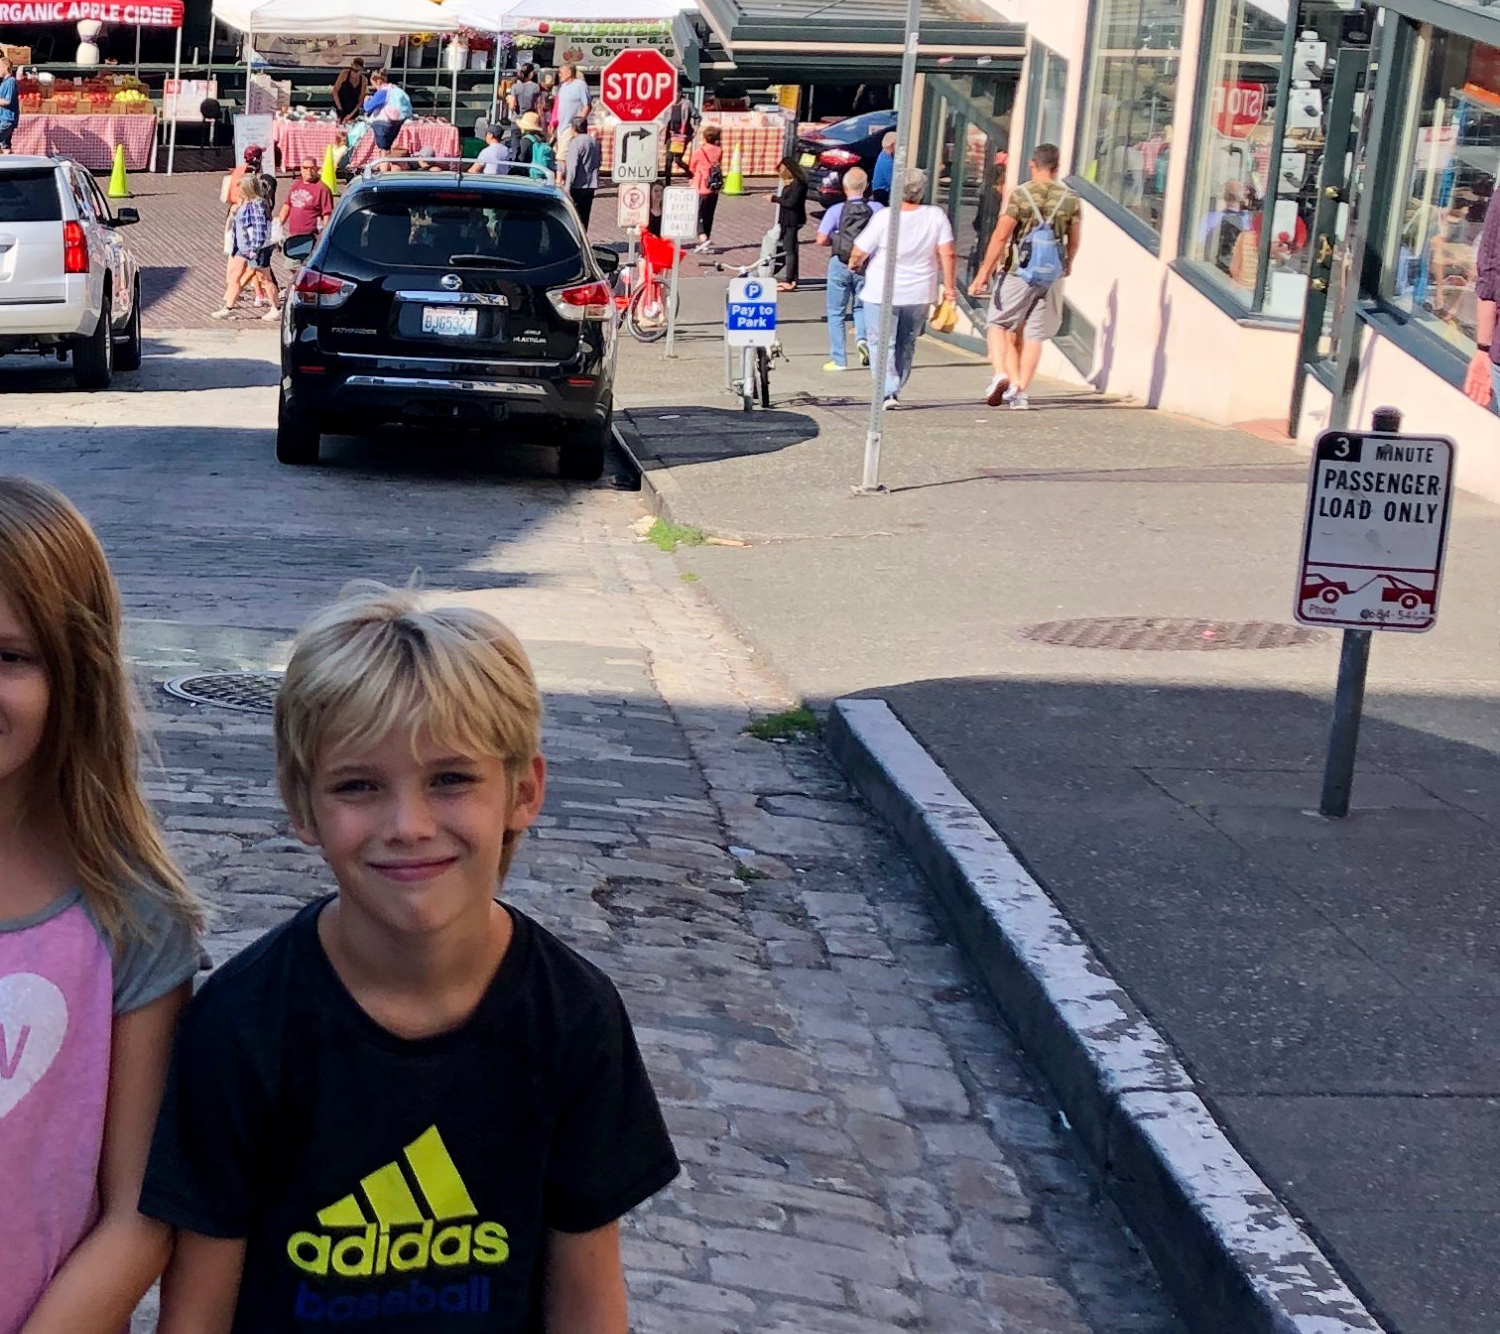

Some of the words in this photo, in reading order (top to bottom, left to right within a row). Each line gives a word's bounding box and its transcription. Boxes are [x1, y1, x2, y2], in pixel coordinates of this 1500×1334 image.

[67, 2, 121, 22] APPLE
[123, 5, 174, 25] CIDER
[605, 71, 672, 101] STOP
[617, 165, 653, 179] ONLY
[748, 284, 759, 297] P
[731, 304, 756, 318] Pay
[759, 305, 774, 316] to
[737, 316, 767, 328] Park
[1333, 436, 1350, 458] 3
[1374, 444, 1435, 464] MINUTE
[1323, 468, 1441, 497] PASSENGER
[1318, 496, 1372, 520] LOAD
[1384, 500, 1439, 524] ONLY
[286, 1218, 510, 1278] adidas
[293, 1273, 491, 1323] baseball
